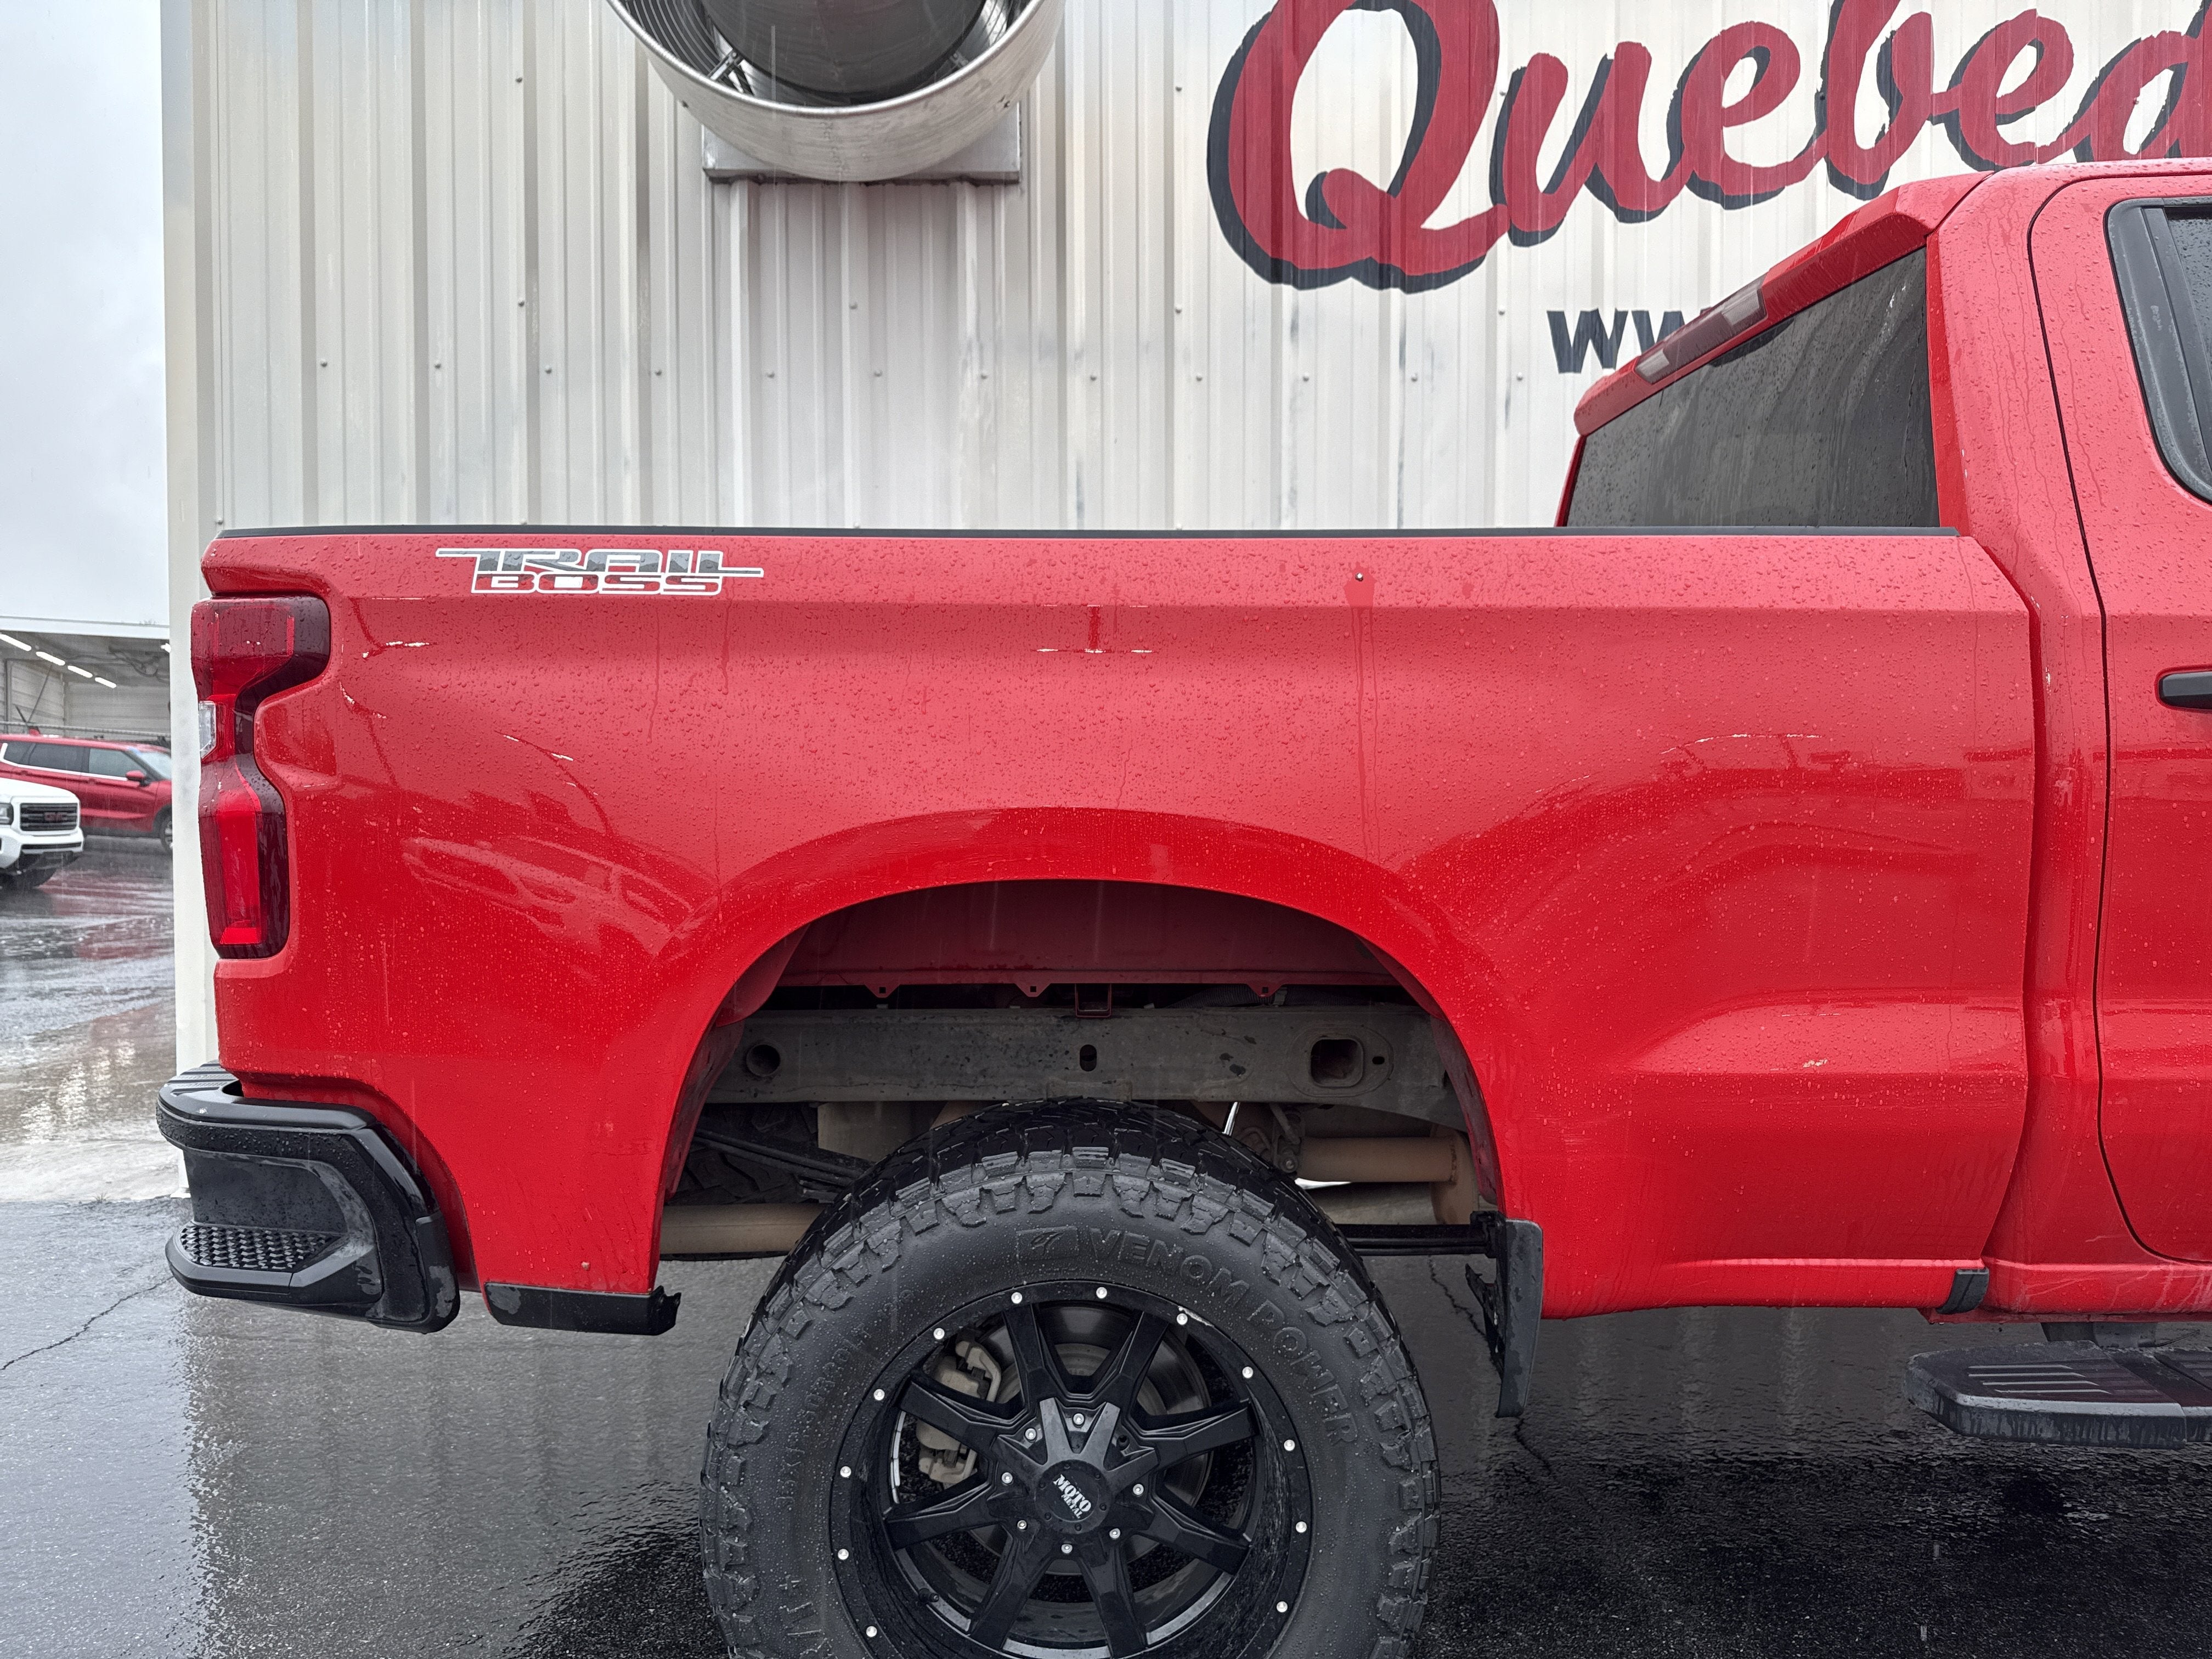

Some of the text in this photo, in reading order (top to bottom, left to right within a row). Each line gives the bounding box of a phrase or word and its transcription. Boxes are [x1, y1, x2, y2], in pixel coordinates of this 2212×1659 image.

[436, 548, 764, 578] TRAIL
[471, 571, 723, 596] BOSS
[1088, 1226, 1359, 1443] VENOM POWER
[1053, 1474, 1092, 1512] MOTO
